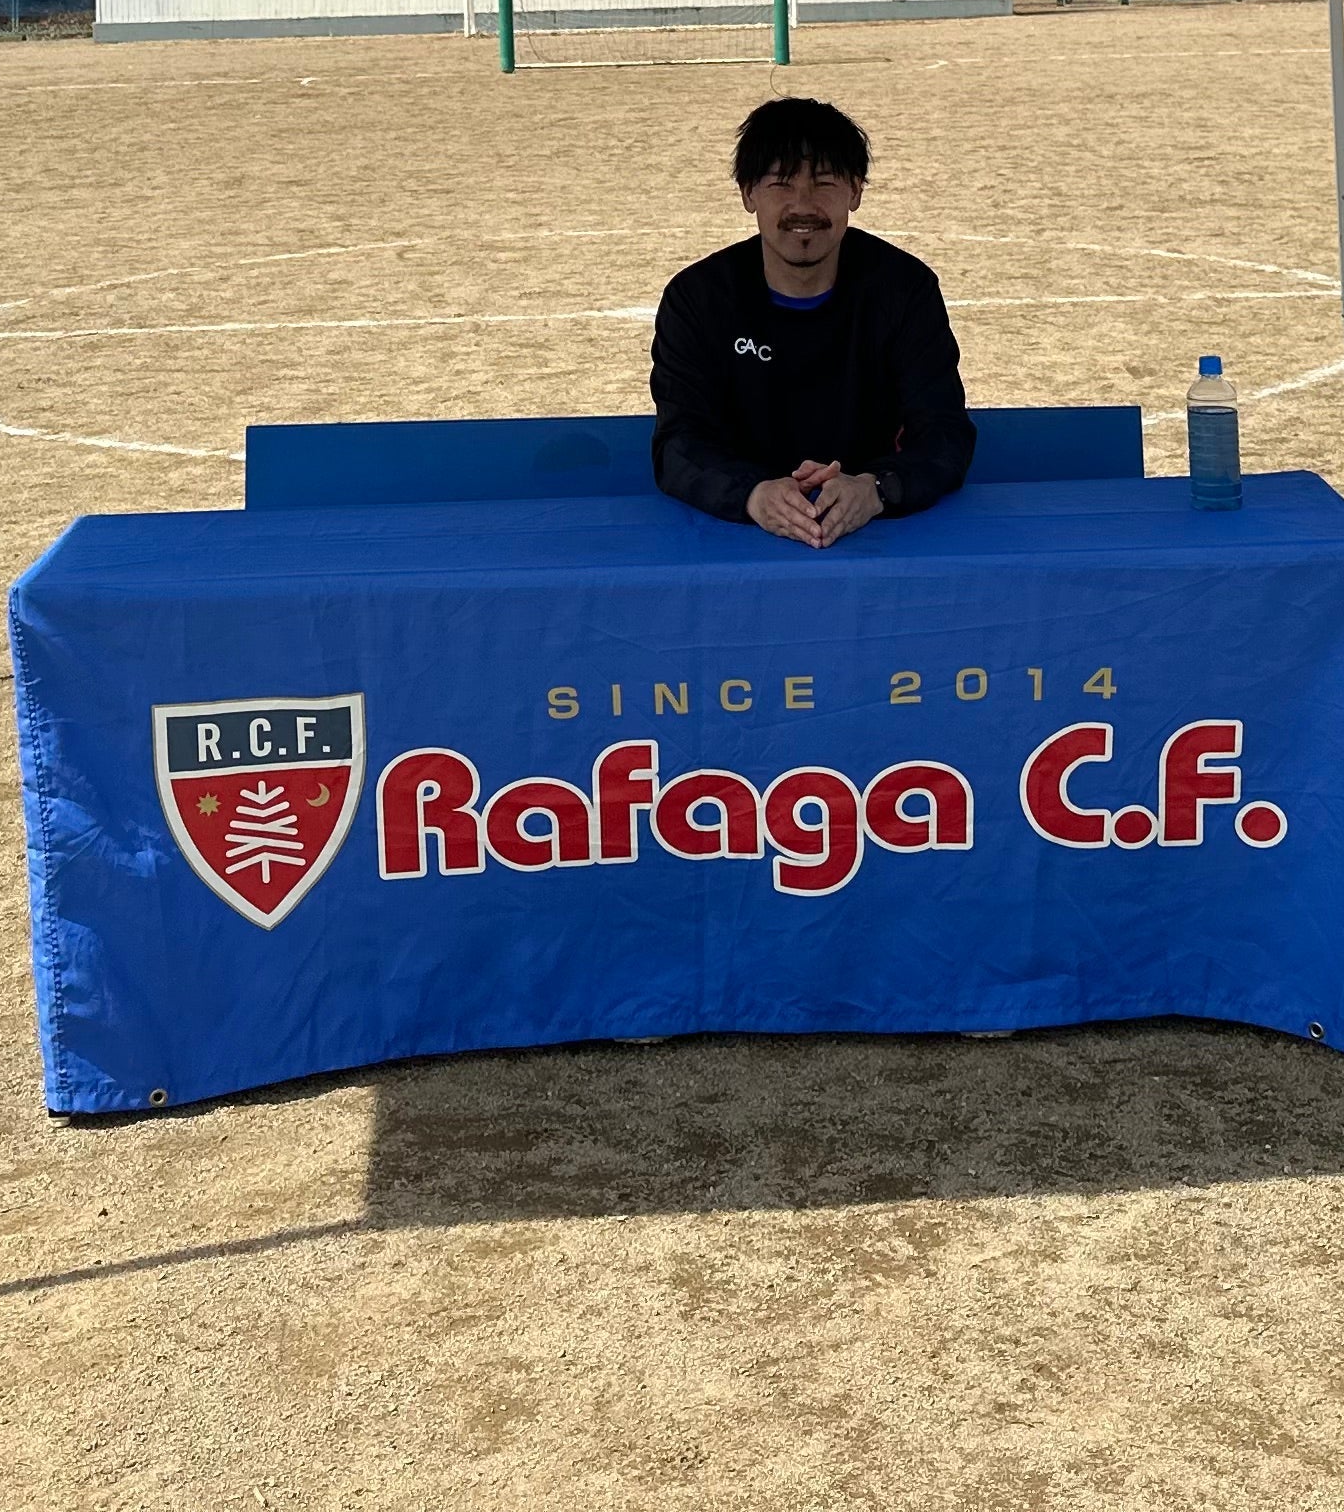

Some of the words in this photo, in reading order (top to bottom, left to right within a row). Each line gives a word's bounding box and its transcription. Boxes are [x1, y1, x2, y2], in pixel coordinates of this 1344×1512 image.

[546, 675, 816, 720] SINCE
[889, 667, 1118, 705] 2014
[196, 716, 332, 763] R.C.F.
[377, 740, 974, 897] Rafaga
[1021, 719, 1288, 850] C.F.
